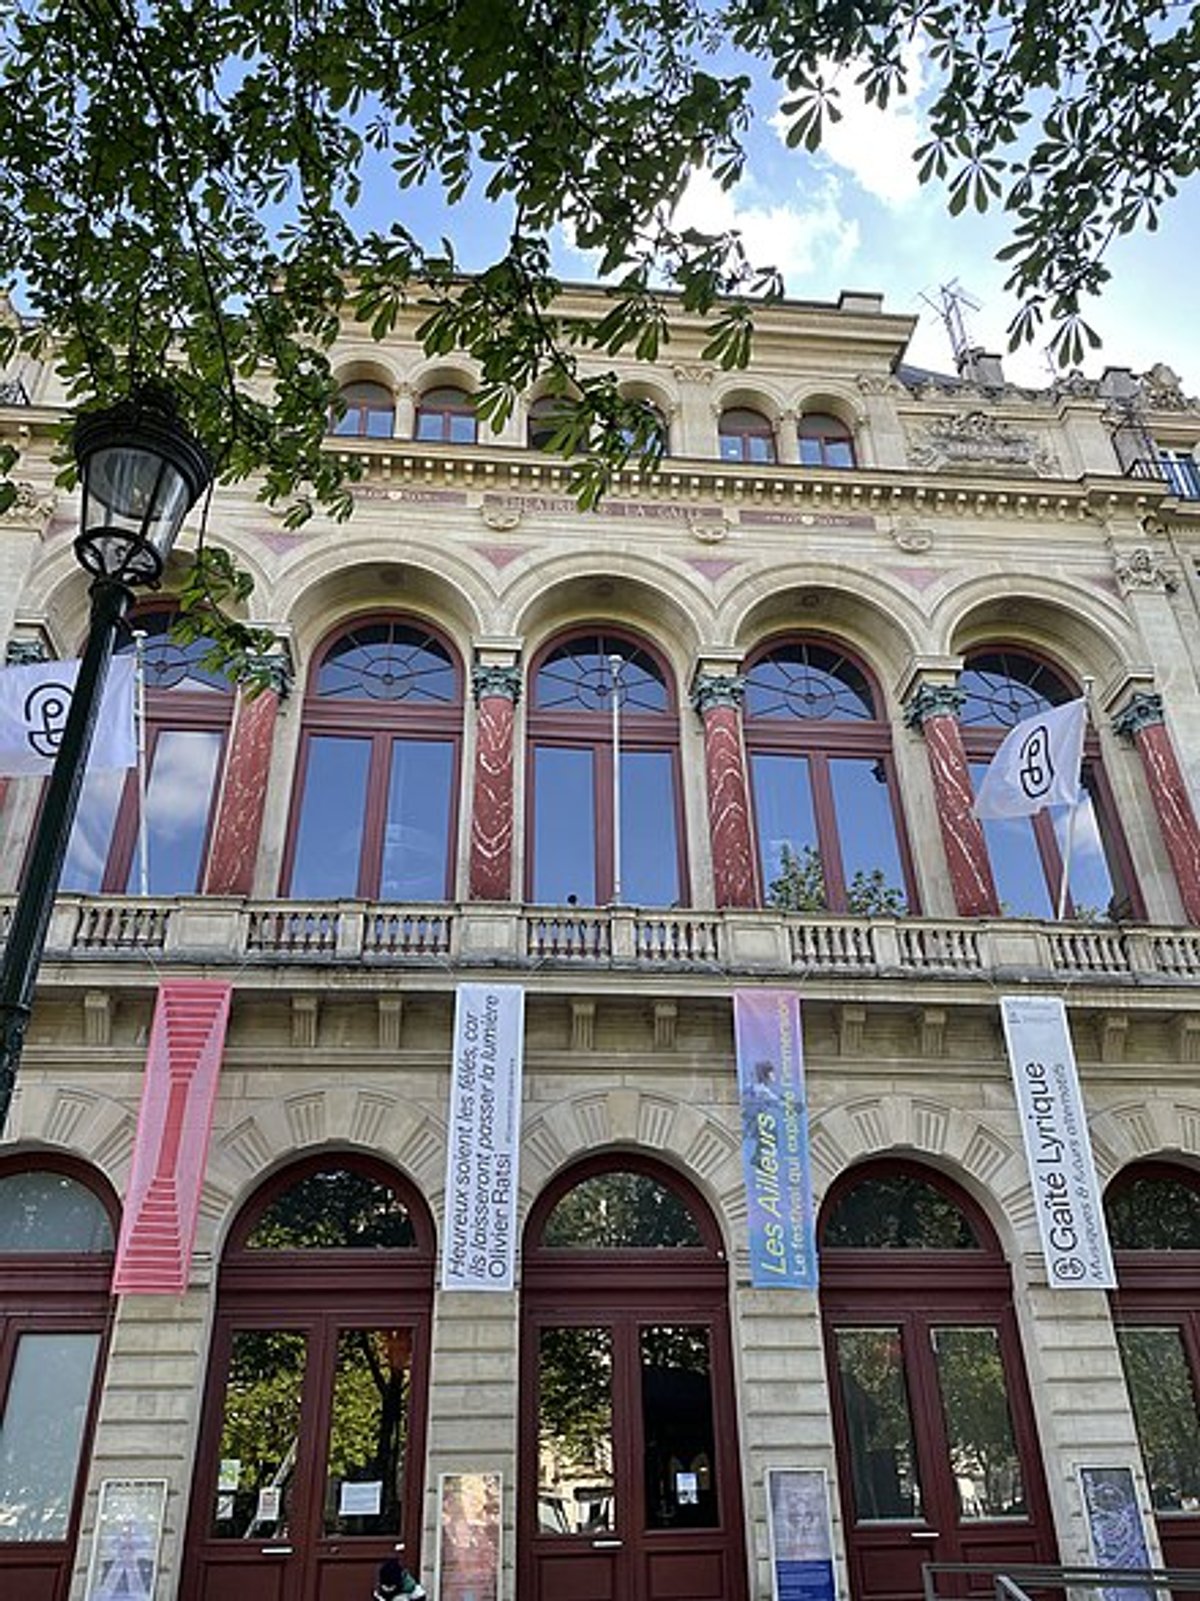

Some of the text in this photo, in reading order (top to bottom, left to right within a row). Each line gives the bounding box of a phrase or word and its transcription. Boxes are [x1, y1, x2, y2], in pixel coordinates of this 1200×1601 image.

[464, 1011, 478, 1042] car
[456, 1096, 474, 1122] les
[469, 995, 499, 1278] ils laisseront passer la lumière
[1025, 1062, 1064, 1163] Lyrique
[454, 1126, 472, 1185] soient
[491, 1153, 511, 1204] Ratsi
[784, 1157, 803, 1182] qui
[1071, 1139, 1086, 1184] futurs
[756, 1113, 787, 1275] Les Ailleurs
[788, 1186, 804, 1249] festival
[1039, 1172, 1077, 1252] Gaîté
[1075, 1187, 1089, 1199] &
[448, 1190, 468, 1278] Heureux
[488, 1209, 508, 1278] Olivier
[793, 1254, 805, 1275] Le
[1082, 1203, 1103, 1279] Musiques
